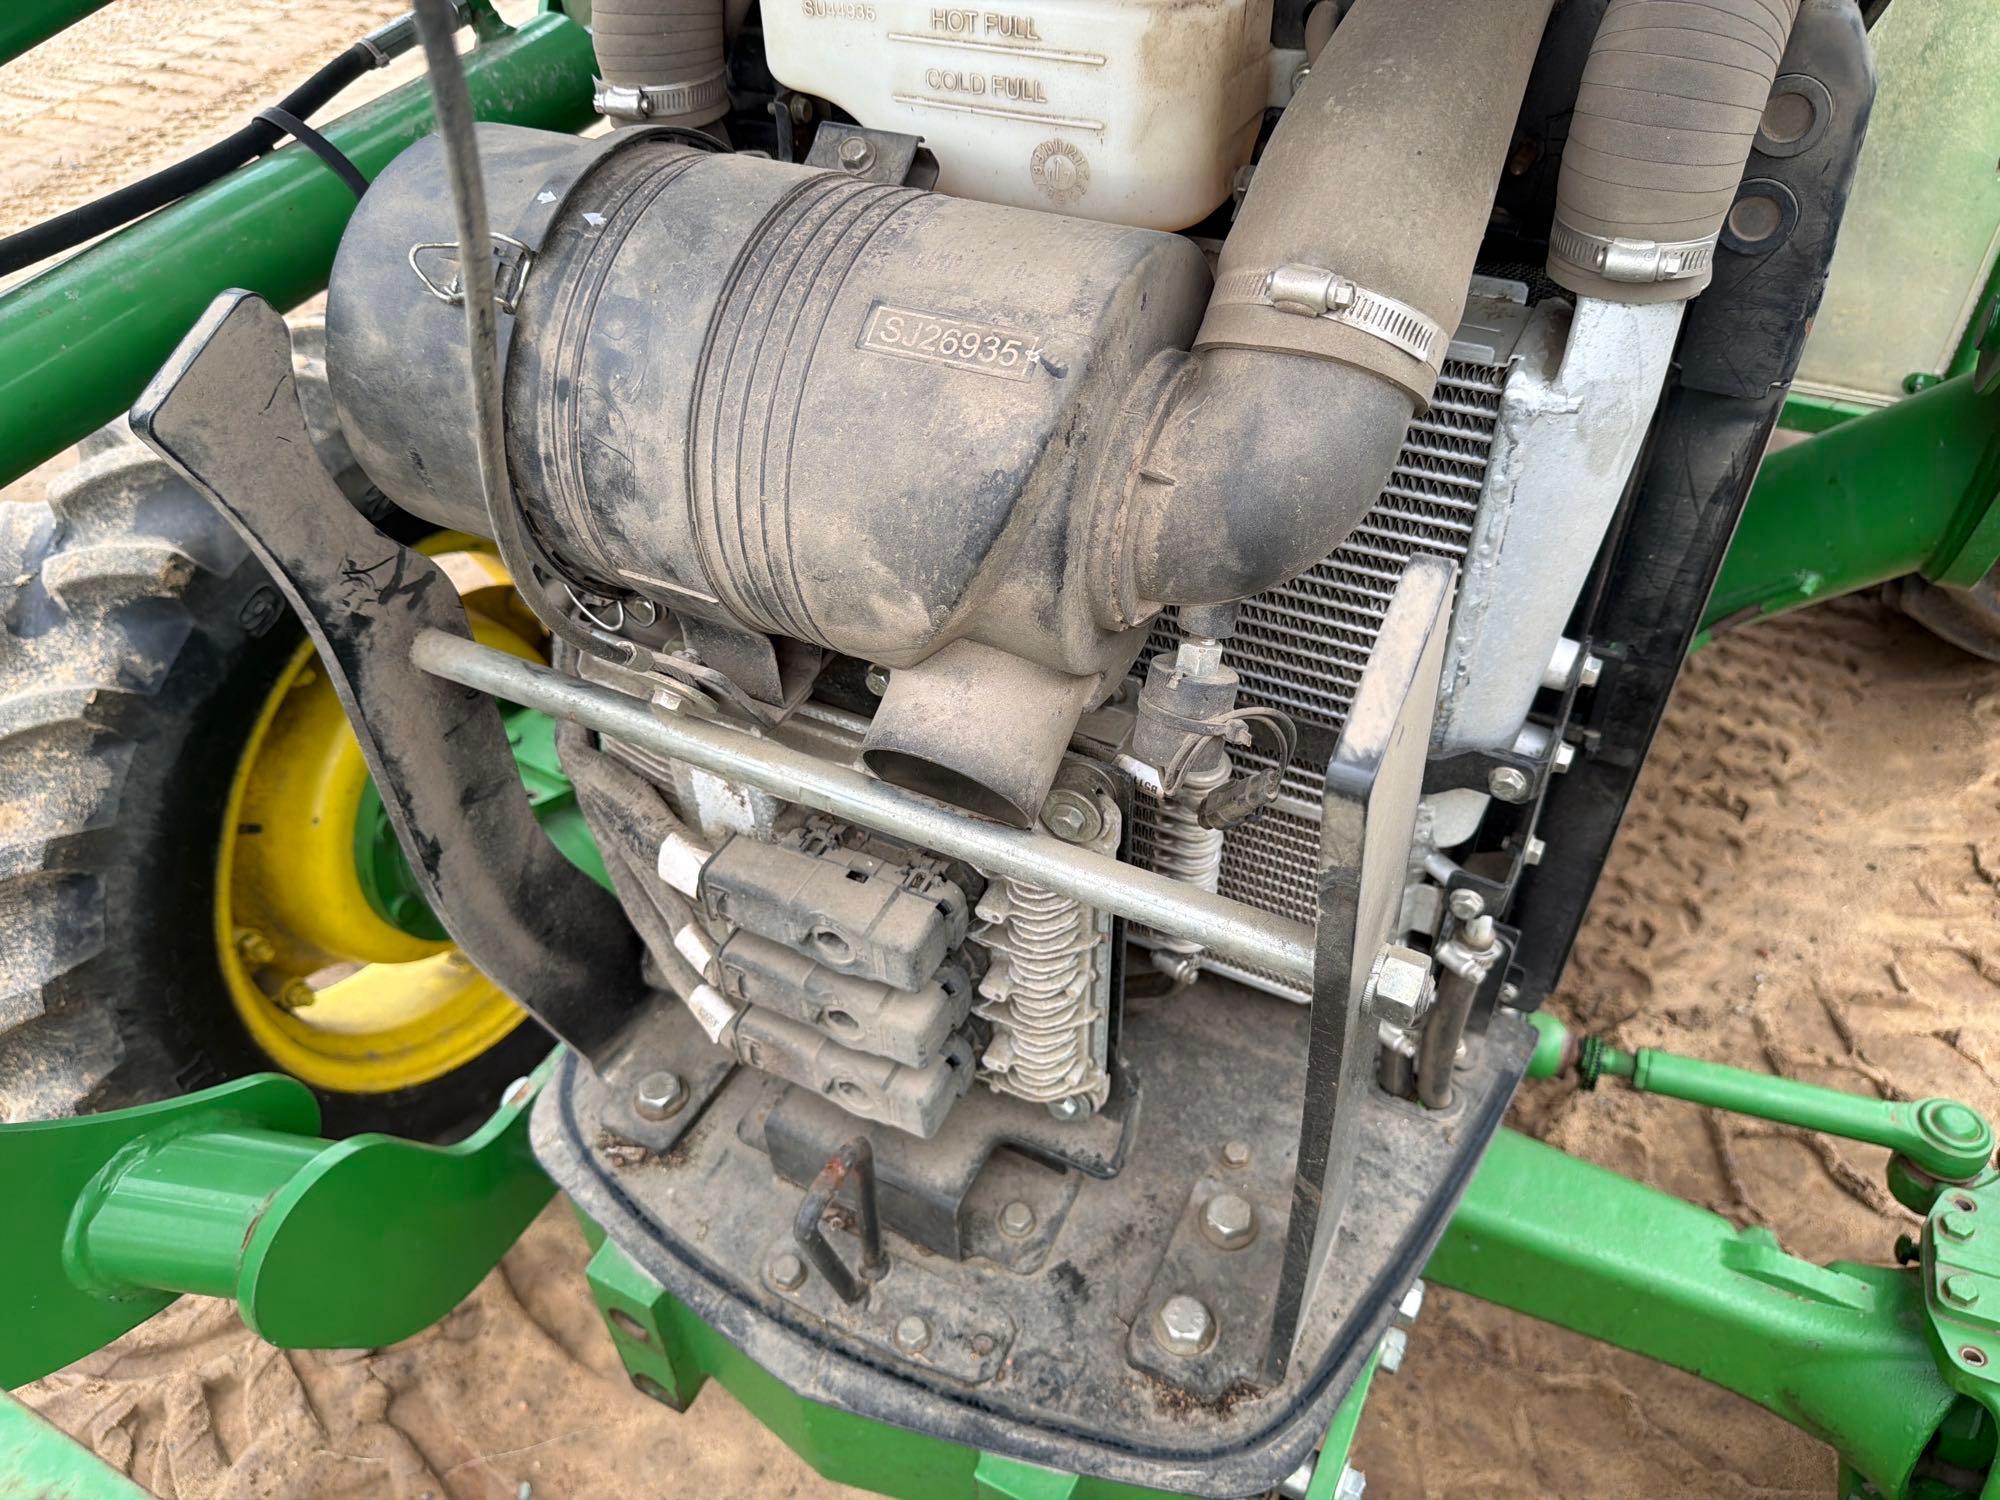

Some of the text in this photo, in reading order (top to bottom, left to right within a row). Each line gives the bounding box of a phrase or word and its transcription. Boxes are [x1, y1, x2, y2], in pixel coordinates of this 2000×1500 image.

[931, 8, 1041, 40] HOT FULL
[926, 68, 1047, 103] COLD FULL
[879, 315, 1022, 367] SJ26935
